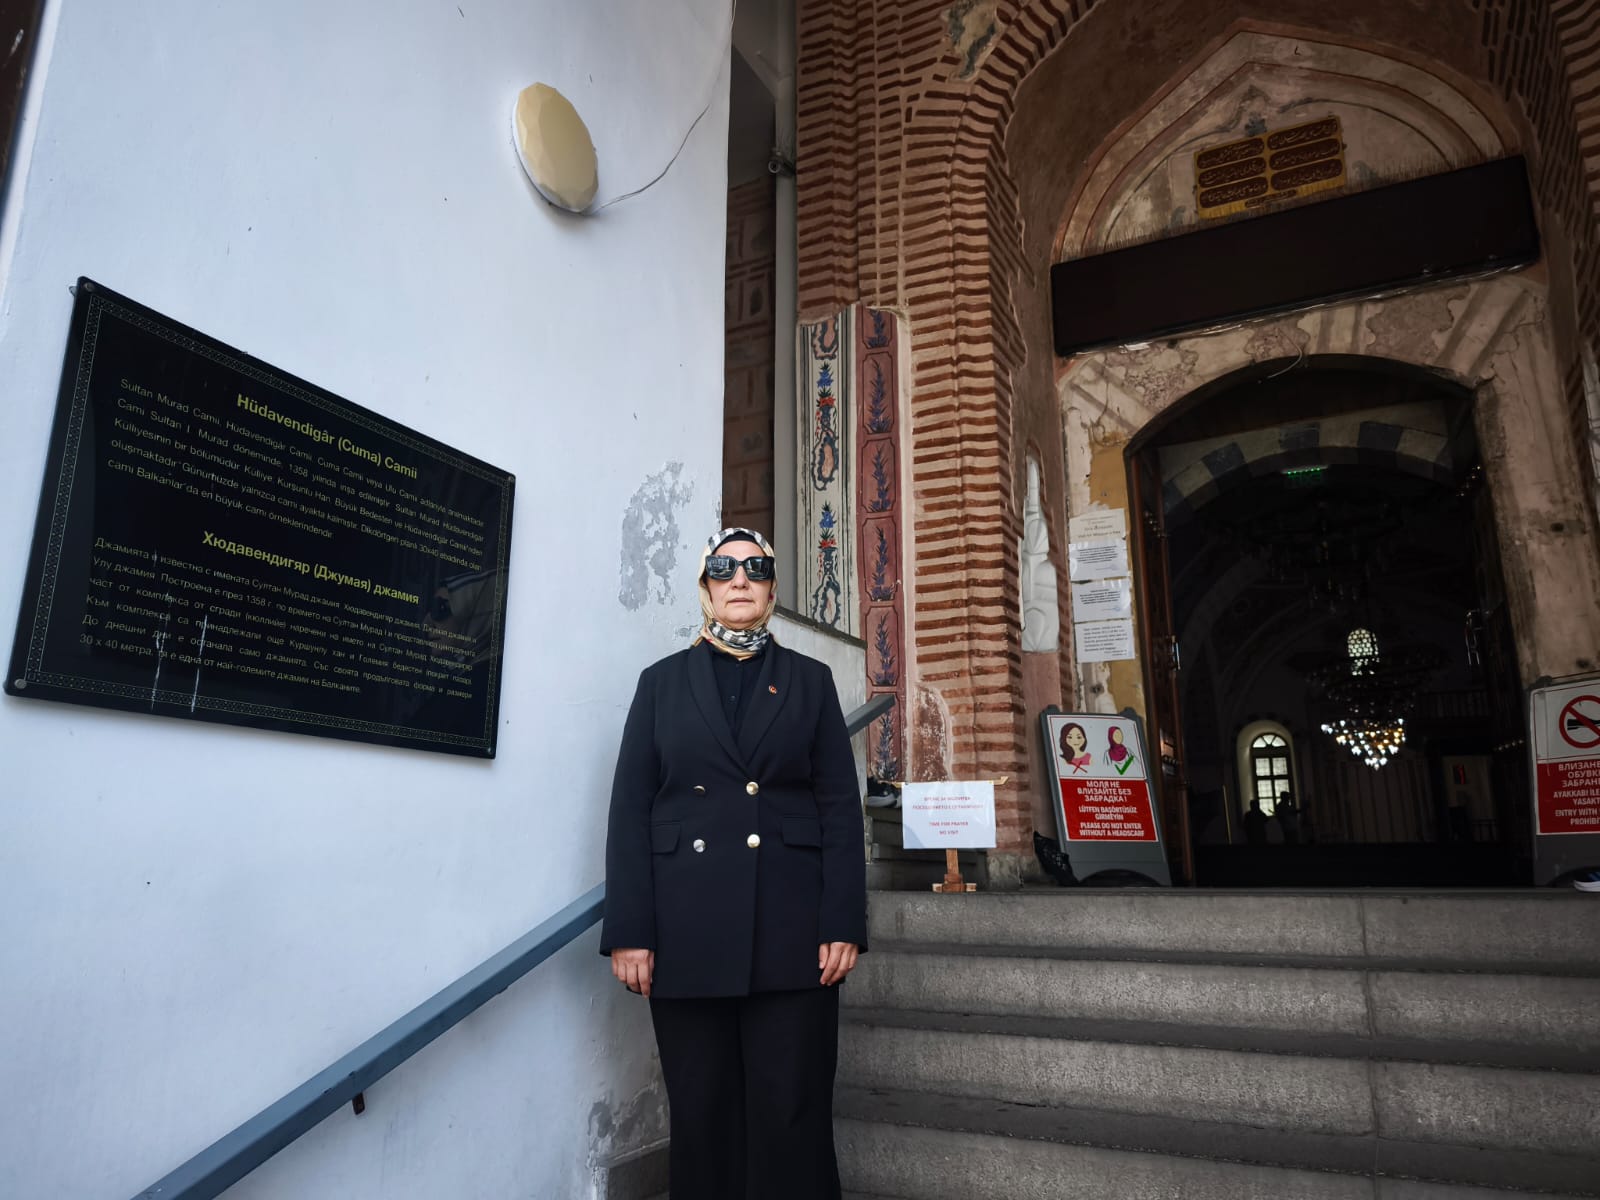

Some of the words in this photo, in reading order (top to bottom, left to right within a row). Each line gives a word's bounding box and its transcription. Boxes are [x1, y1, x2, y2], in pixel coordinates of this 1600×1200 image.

[120, 378, 153, 398] Sultan
[157, 393, 189, 413] Murad
[317, 457, 340, 472] Cuma
[366, 478, 383, 488] veya
[385, 484, 397, 494] Ulu
[174, 440, 187, 450] bir
[237, 393, 335, 444] Hüdavendigâr
[338, 436, 381, 467] (Cuma)
[384, 456, 417, 479] Camii
[150, 411, 182, 428] Sultan
[198, 428, 229, 447] Murad
[289, 464, 308, 477] 1358
[419, 512, 440, 526] Murad
[201, 491, 213, 499] en
[94, 537, 149, 559] Джамията
[160, 556, 203, 573] известна
[213, 570, 250, 585] имената
[252, 579, 281, 592] Султан
[283, 587, 309, 601] Мурад
[202, 530, 310, 574] Хюдавендигяр
[314, 563, 371, 592] (Джумая)
[373, 584, 419, 604] джамия
[89, 578, 113, 588] част
[209, 605, 241, 617] сгради
[94, 557, 112, 569] Улу
[161, 573, 212, 593] Построена
[222, 590, 243, 601] през
[247, 595, 266, 606] 1358
[288, 606, 321, 620] времето
[333, 616, 359, 628] Султан
[360, 623, 383, 636] Мурад
[82, 614, 98, 625] До
[105, 621, 146, 634] днешни
[239, 648, 261, 657] само
[313, 661, 328, 671] Със
[86, 594, 109, 607] Към
[116, 603, 171, 624] комплекса
[177, 616, 189, 625] са
[267, 636, 284, 645] още
[289, 640, 327, 655] Куршунлу
[79, 634, 93, 644] 30
[105, 640, 118, 648] 40
[178, 654, 202, 664] една
[1077, 787, 1117, 795] ВЛИЗАЙТЕ
[1554, 789, 1588, 798] AYAKKABI
[1568, 770, 1600, 779] ОБУВК
[1085, 795, 1123, 803] ЗАБРАДКА
[1555, 809, 1577, 817] ENTRY
